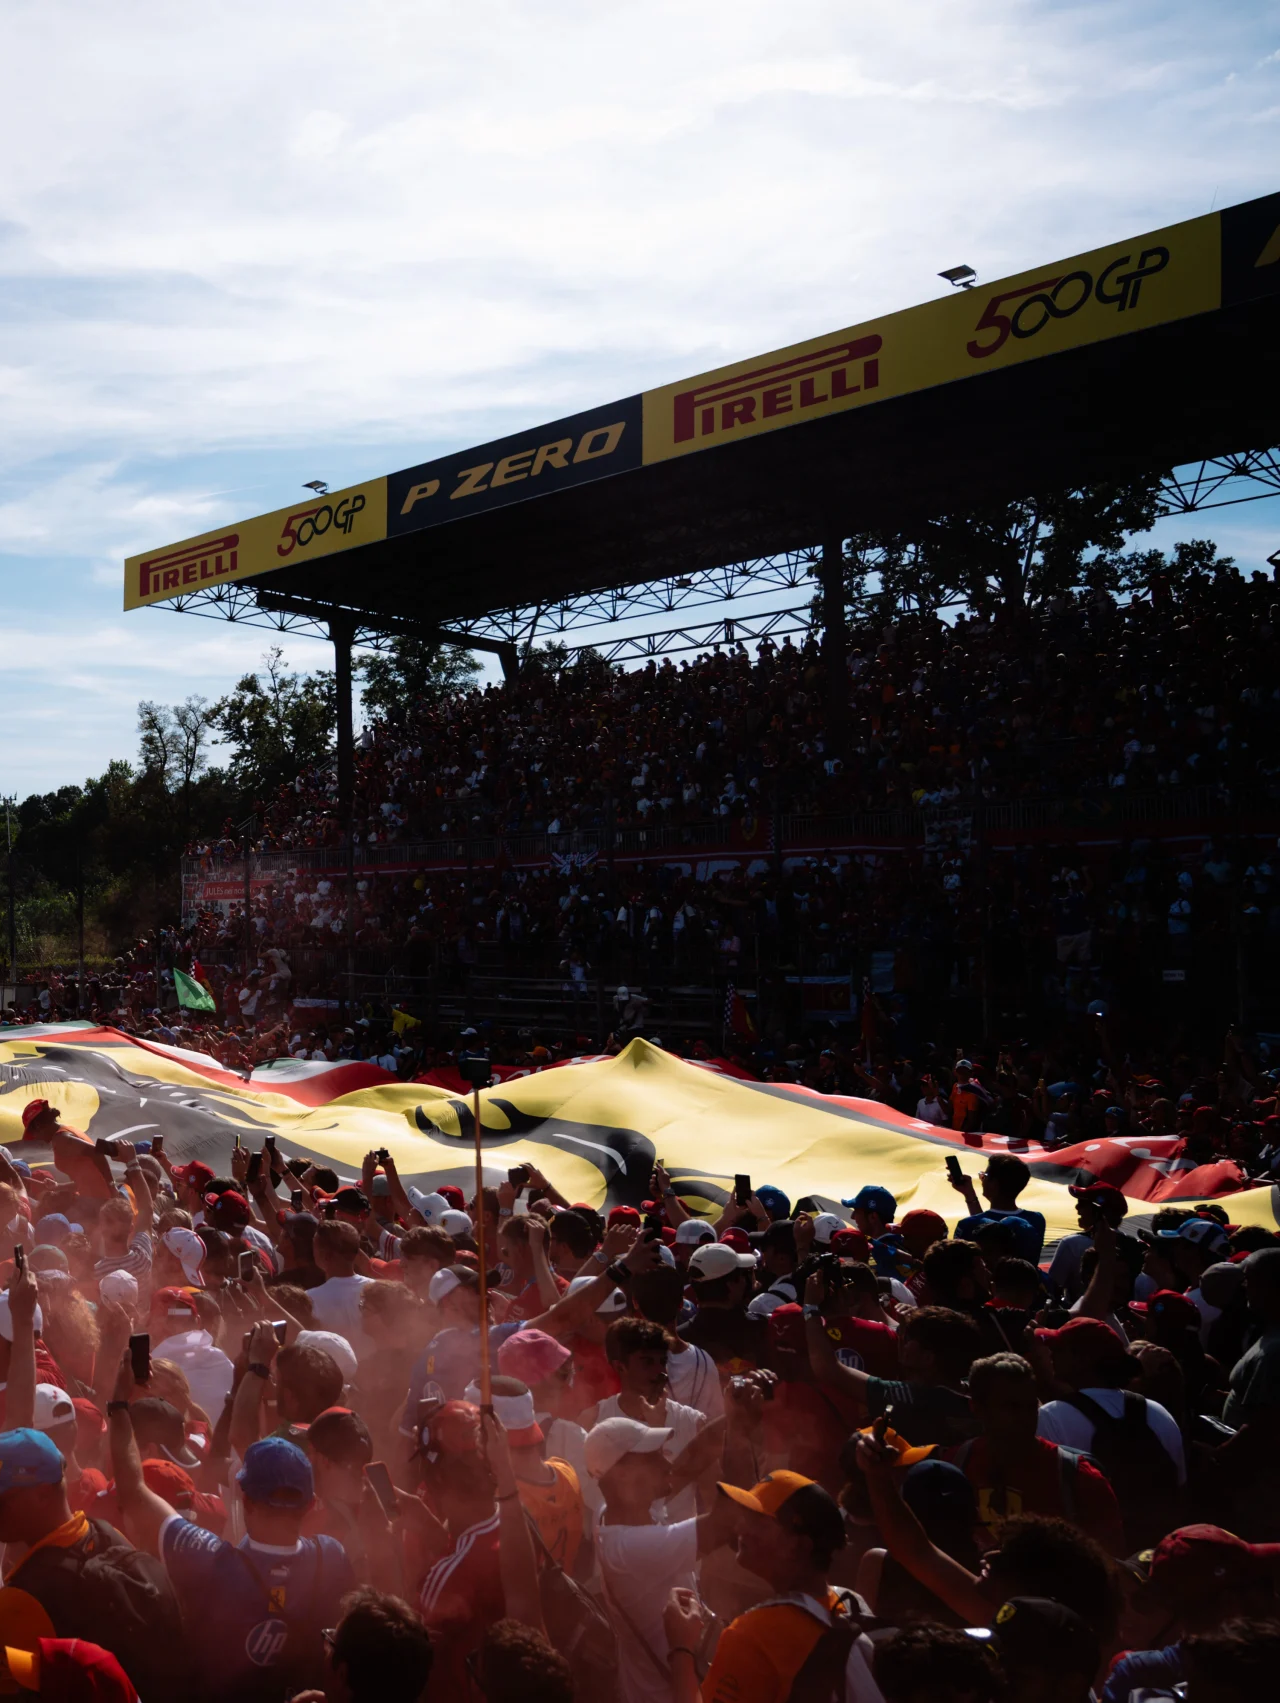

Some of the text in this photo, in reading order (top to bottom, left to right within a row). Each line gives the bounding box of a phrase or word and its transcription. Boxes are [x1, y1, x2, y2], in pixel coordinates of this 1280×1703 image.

[673, 334, 883, 444] PIRELLI
[400, 422, 626, 515] P ZERO
[140, 533, 239, 597] PIRELLI
[205, 886, 223, 897] JULES
[258, 1630, 289, 1667] hp
